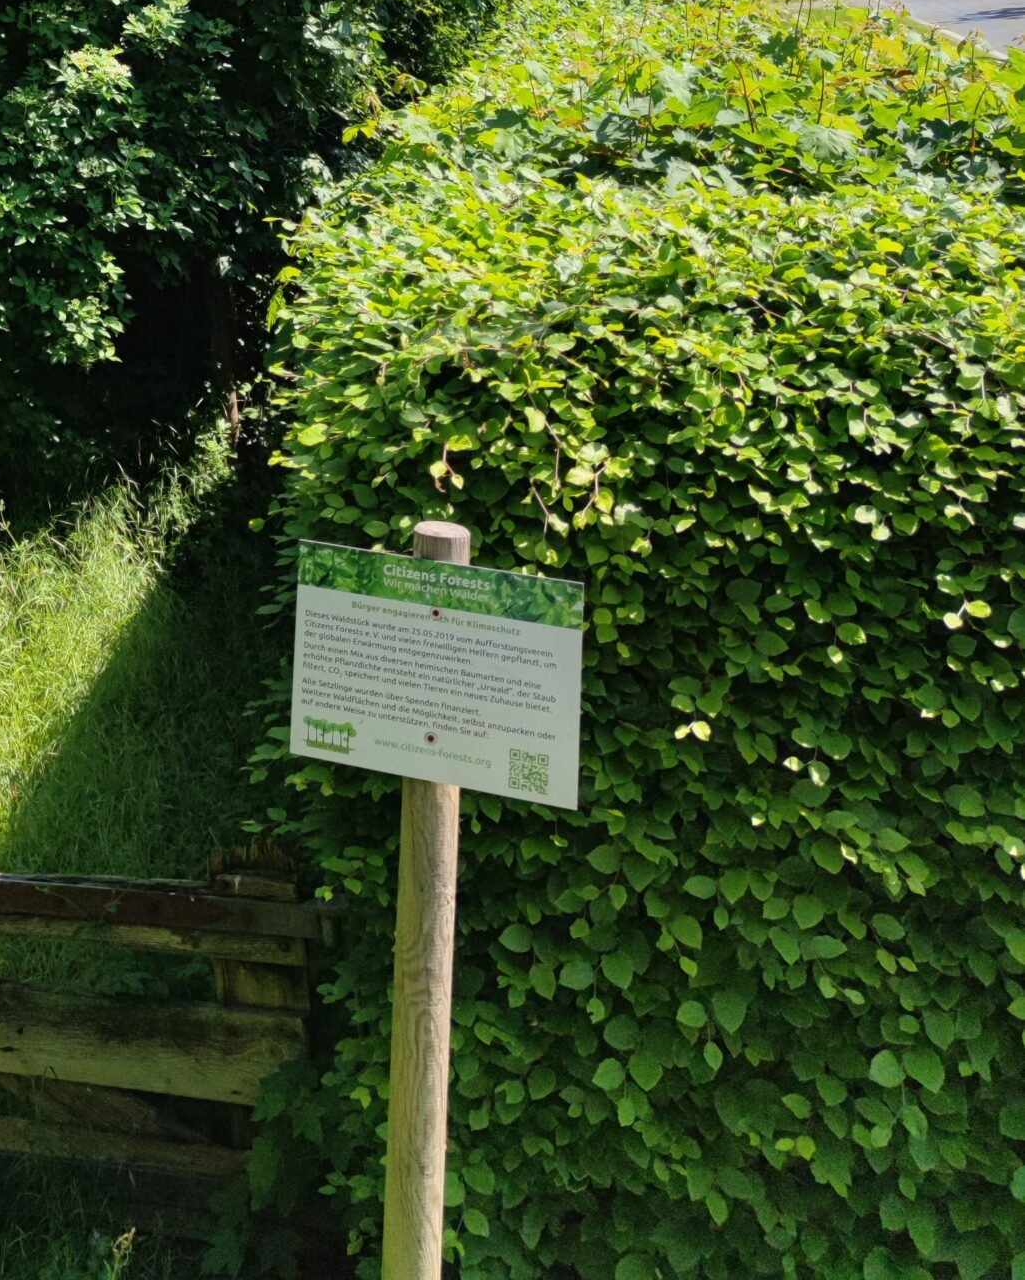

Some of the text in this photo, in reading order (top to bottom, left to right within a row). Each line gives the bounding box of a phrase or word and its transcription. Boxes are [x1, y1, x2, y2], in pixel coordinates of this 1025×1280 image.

[383, 563, 490, 591] Citizens Forests
[383, 576, 400, 588] Wir
[449, 586, 488, 602] Wälder
[305, 609, 552, 658] Dieses Waldstück wurde am 25.05.2019 vom Aufforstungsverein
[351, 600, 380, 613] Bürger
[382, 607, 430, 621] engagieren
[451, 616, 464, 626] für
[466, 619, 520, 636] Klimaschutz
[304, 619, 333, 631] Citizens
[335, 624, 363, 636] Forests
[381, 633, 396, 641] und
[397, 635, 420, 646] vielen
[422, 639, 466, 653] freiwilligen
[469, 647, 498, 659] Helfern
[500, 654, 541, 668] gepflanzt,
[543, 661, 556, 669] um
[304, 629, 472, 665] der globalen Erwärmung entgegenzuwirken.
[303, 641, 541, 689] Durch einen Mix aus diversen heimischen Baumarten und eine
[334, 656, 381, 671] Pflanzdichte
[383, 666, 415, 678] entsteht
[418, 672, 429, 680] ein
[431, 675, 474, 688] natürlicher
[516, 688, 529, 698] der
[532, 691, 556, 703] Staub
[301, 676, 481, 716] Alle Setzlinge wurden über Spenden finanziert.
[344, 670, 379, 682] speichert
[381, 676, 396, 685] und
[397, 678, 421, 689] vielen
[423, 682, 448, 694] Tieren
[450, 688, 461, 696] ein
[464, 691, 487, 701] neues
[489, 694, 523, 708] Zuhause
[525, 701, 553, 713] bietet.
[301, 686, 330, 699] Weitere
[332, 692, 379, 708] Waldflächen
[381, 703, 396, 711] und
[397, 704, 409, 713] die
[461, 717, 485, 727] selbst
[487, 722, 534, 736] anzupacken
[536, 730, 556, 740] oder
[314, 700, 340, 711] andere
[342, 704, 365, 715] Weise
[378, 712, 430, 729] unterstützen,
[432, 720, 457, 733] finden
[459, 726, 471, 735] Sie
[374, 737, 492, 768] www.citizens-forests.org
